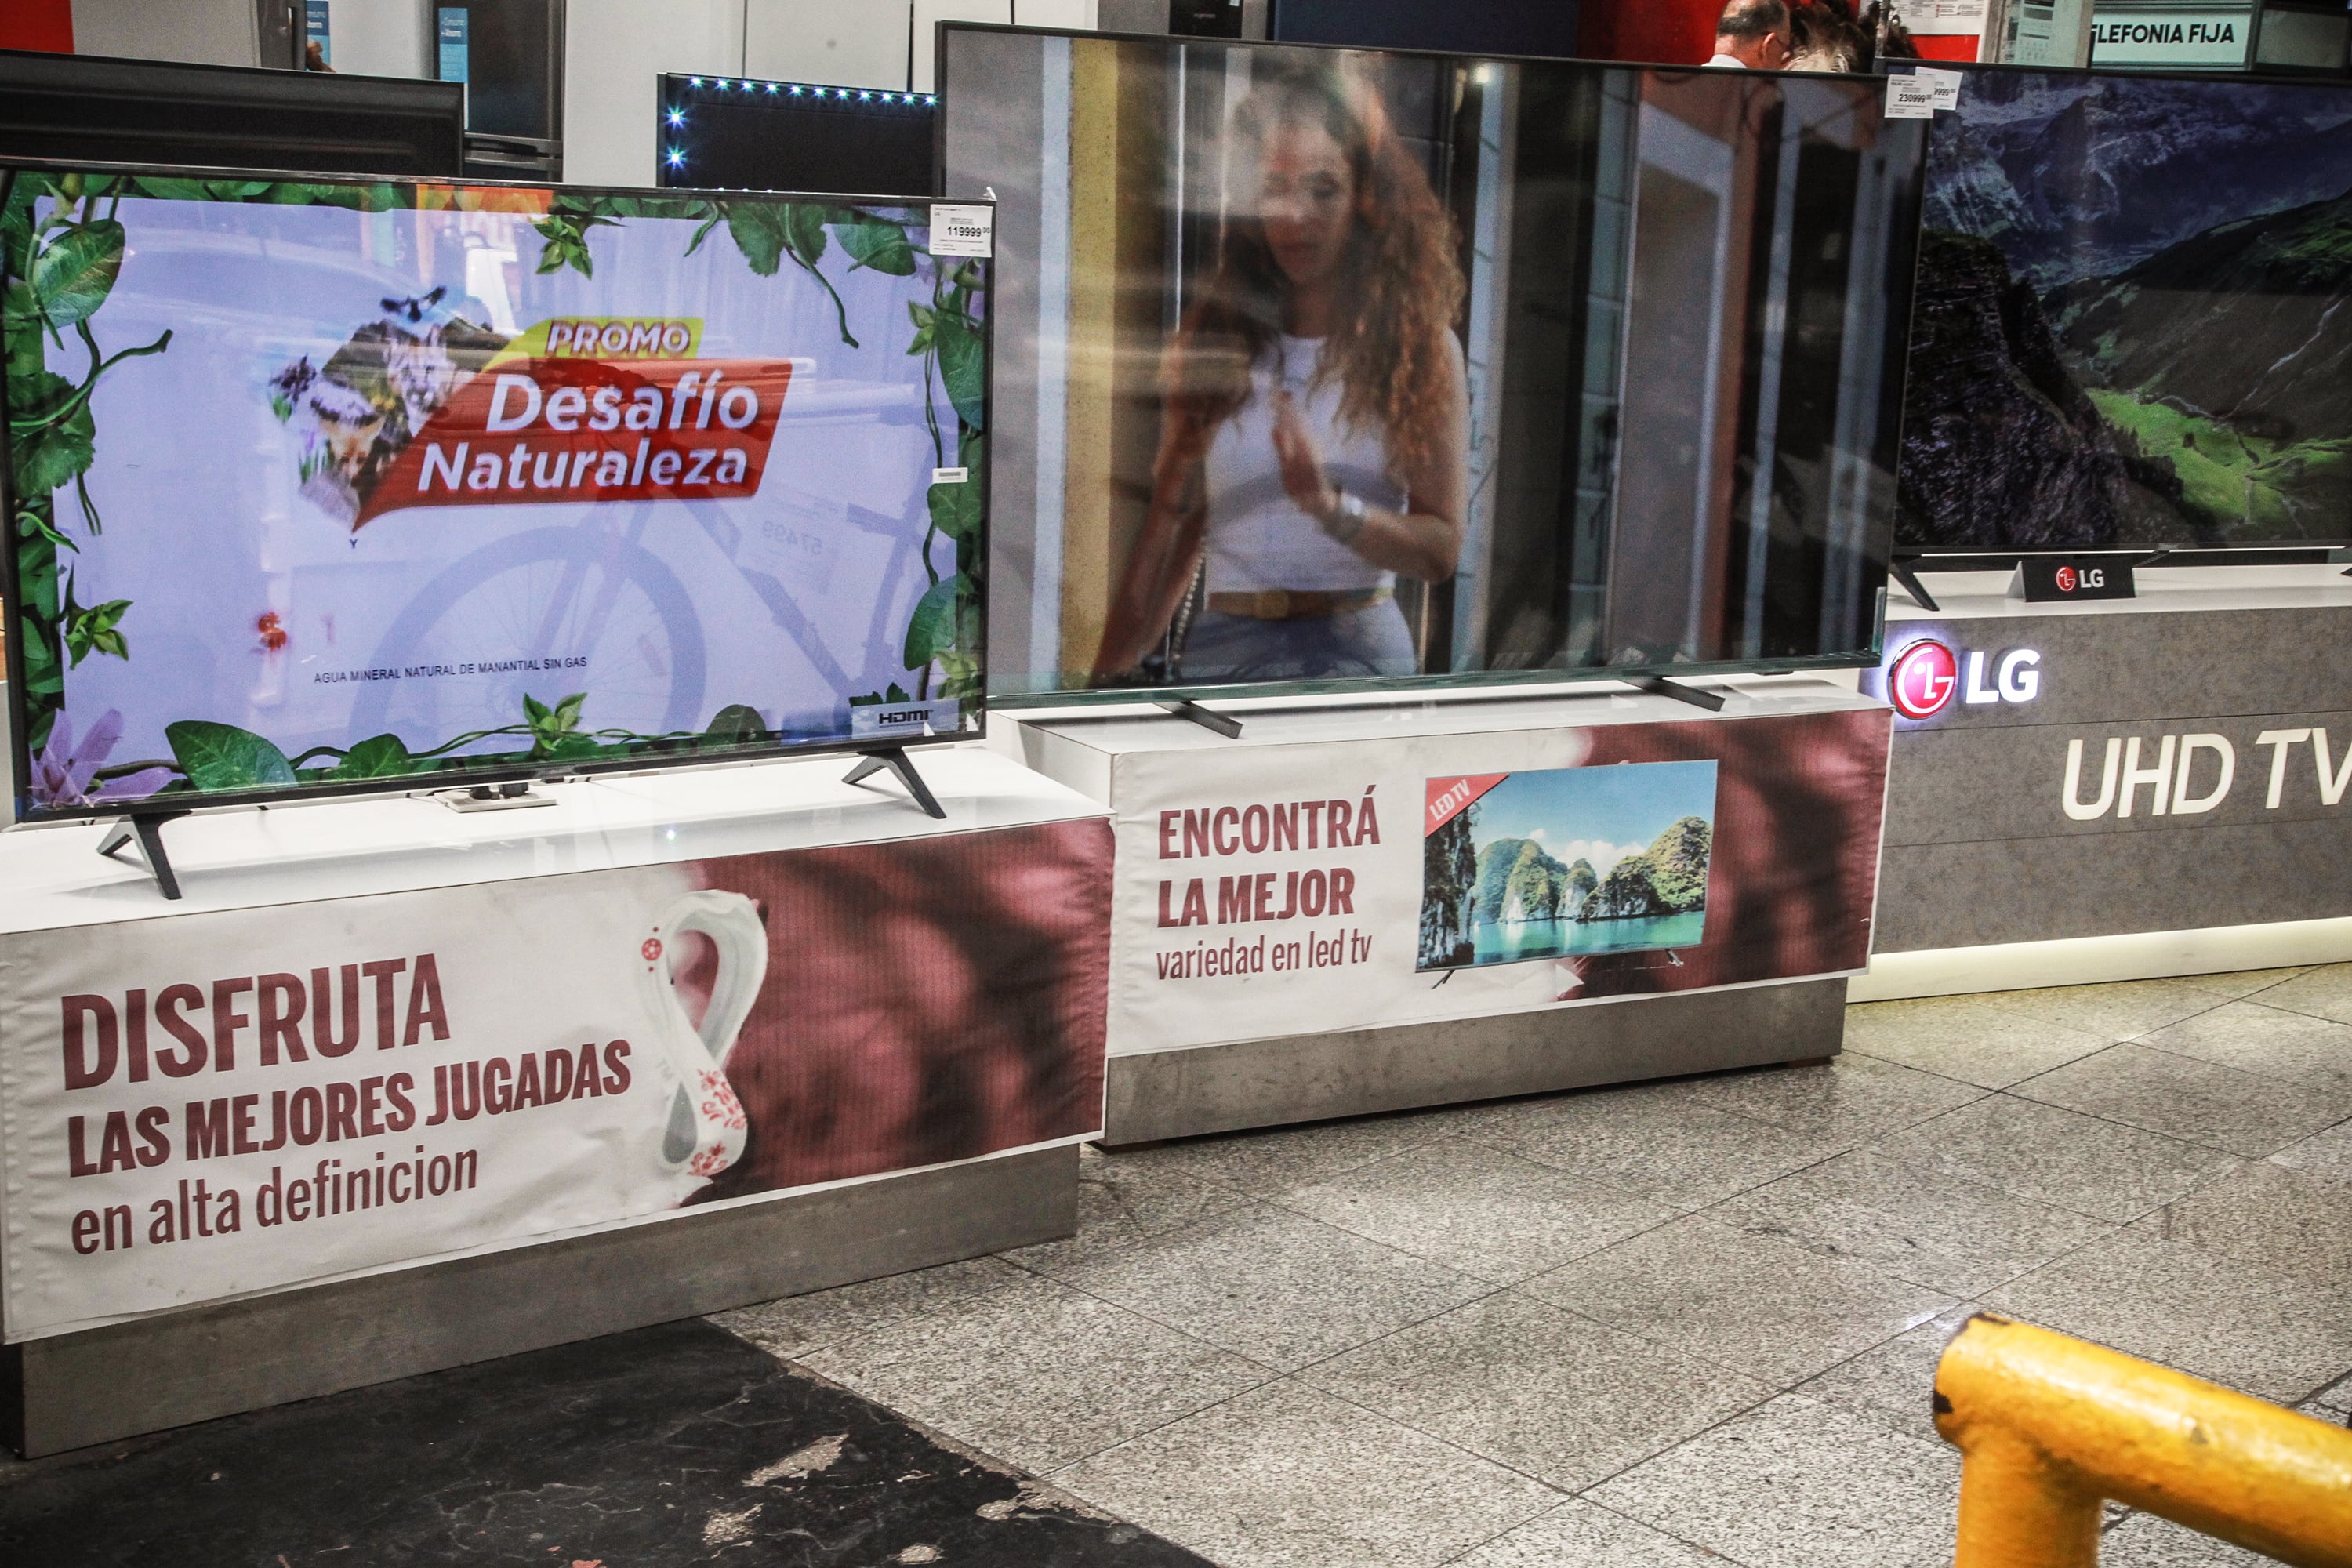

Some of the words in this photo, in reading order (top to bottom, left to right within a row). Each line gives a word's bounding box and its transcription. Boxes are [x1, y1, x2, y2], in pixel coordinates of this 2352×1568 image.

[2189, 24, 2234, 44] FIJA
[947, 227, 982, 237] 119999
[545, 320, 691, 354] PROMO
[485, 368, 760, 432] Desafío
[417, 437, 749, 492] Naturaleza
[2079, 569, 2104, 588] LG
[314, 672, 347, 683] AGUA
[350, 669, 401, 681] MINERAL
[405, 666, 456, 677] NATURAL
[459, 663, 475, 674] DE
[478, 659, 540, 673] MANANTIAL
[543, 659, 561, 669] SIN
[564, 656, 587, 668] GAS
[1965, 649, 2041, 704] LG
[879, 710, 929, 724] HDMI
[1428, 793, 1455, 821] LED
[1450, 779, 1471, 801] TV
[2062, 733, 2236, 821] UHD
[2256, 728, 2352, 809] TV
[1159, 784, 1381, 860] ENCONTRÁ
[1157, 877, 1208, 929] LA
[1218, 867, 1356, 925] MEJOR
[1156, 935, 1265, 981] variedad
[1272, 945, 1301, 972] en
[1308, 928, 1344, 969] led
[1350, 928, 1373, 964] tv
[61, 953, 451, 1091] DISFRUTA
[68, 1105, 171, 1178] LAS
[186, 1072, 416, 1162] MEJORES
[426, 1039, 632, 1127] JUGADAS
[71, 1203, 133, 1255] en
[148, 1178, 241, 1245] alta
[256, 1145, 478, 1228] definicion
